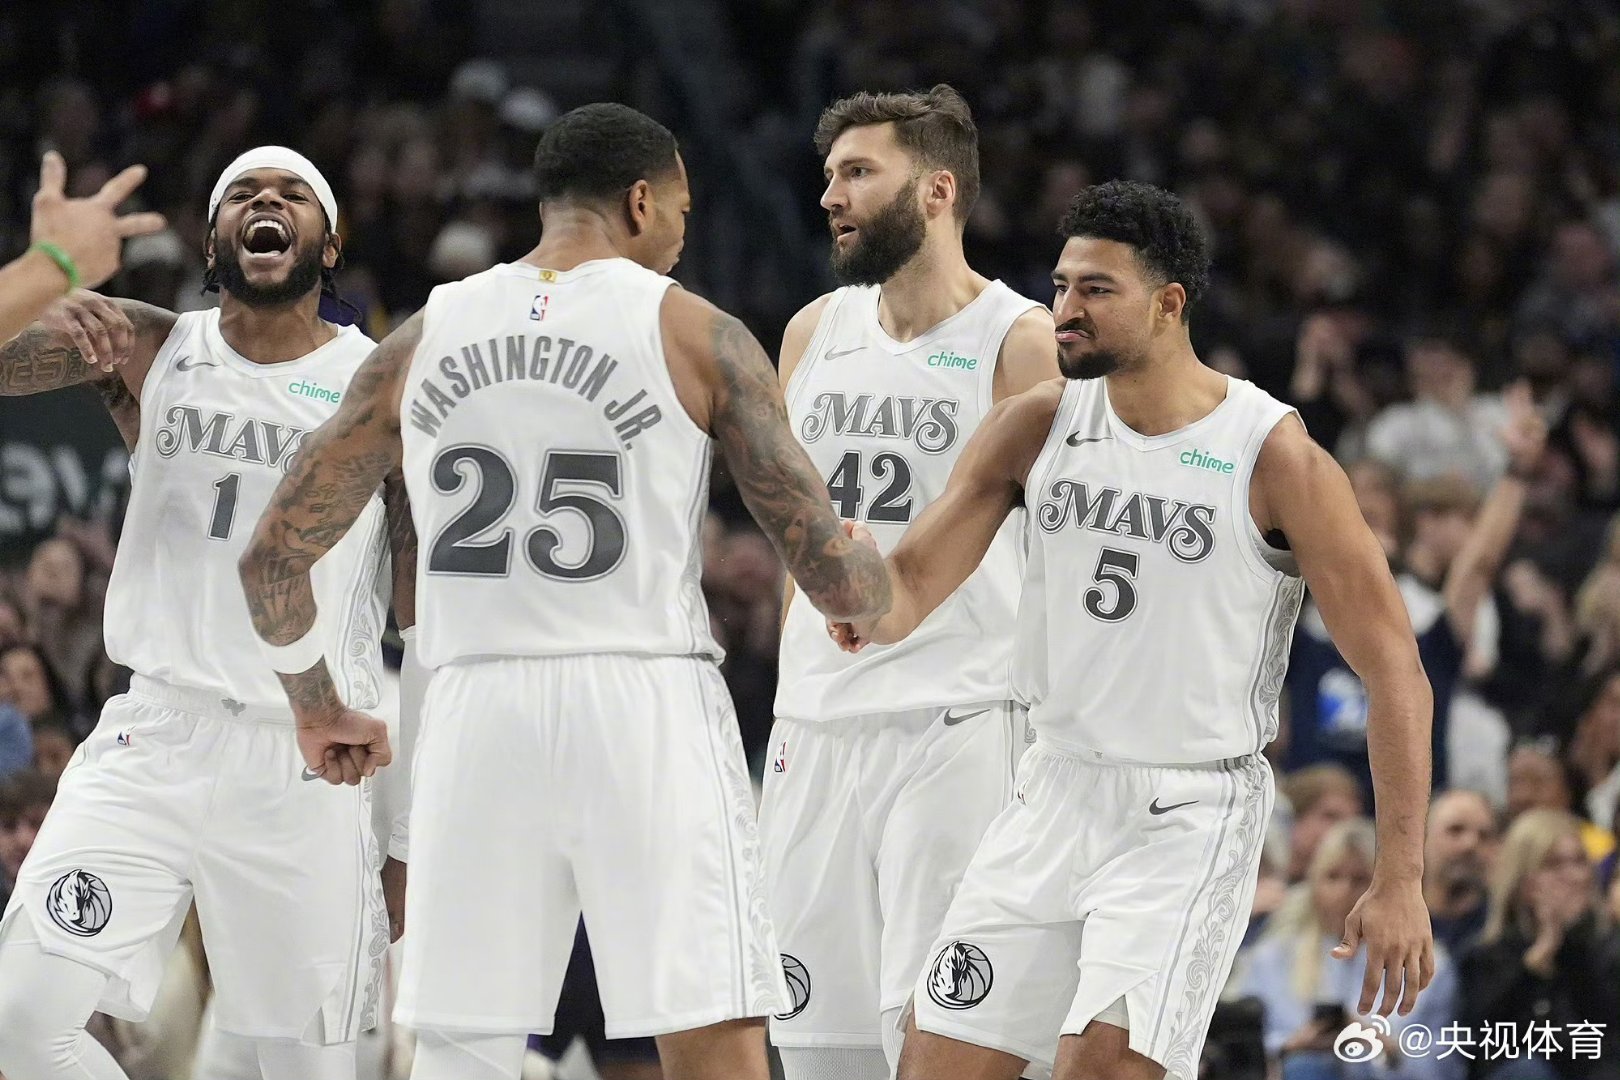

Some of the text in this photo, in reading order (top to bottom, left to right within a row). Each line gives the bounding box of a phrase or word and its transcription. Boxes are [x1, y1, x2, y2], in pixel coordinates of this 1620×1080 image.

[289, 380, 341, 403] chime
[411, 335, 662, 450] WASHINGTON JR.
[928, 352, 977, 370] chime
[156, 405, 313, 475] MAV
[801, 391, 960, 455] MAVS
[826, 450, 913, 524] 42
[1180, 449, 1234, 474] chime
[208, 472, 240, 541] 1
[426, 442, 628, 583] 25
[1038, 478, 1217, 564] MAVS
[1083, 546, 1140, 623] 5
